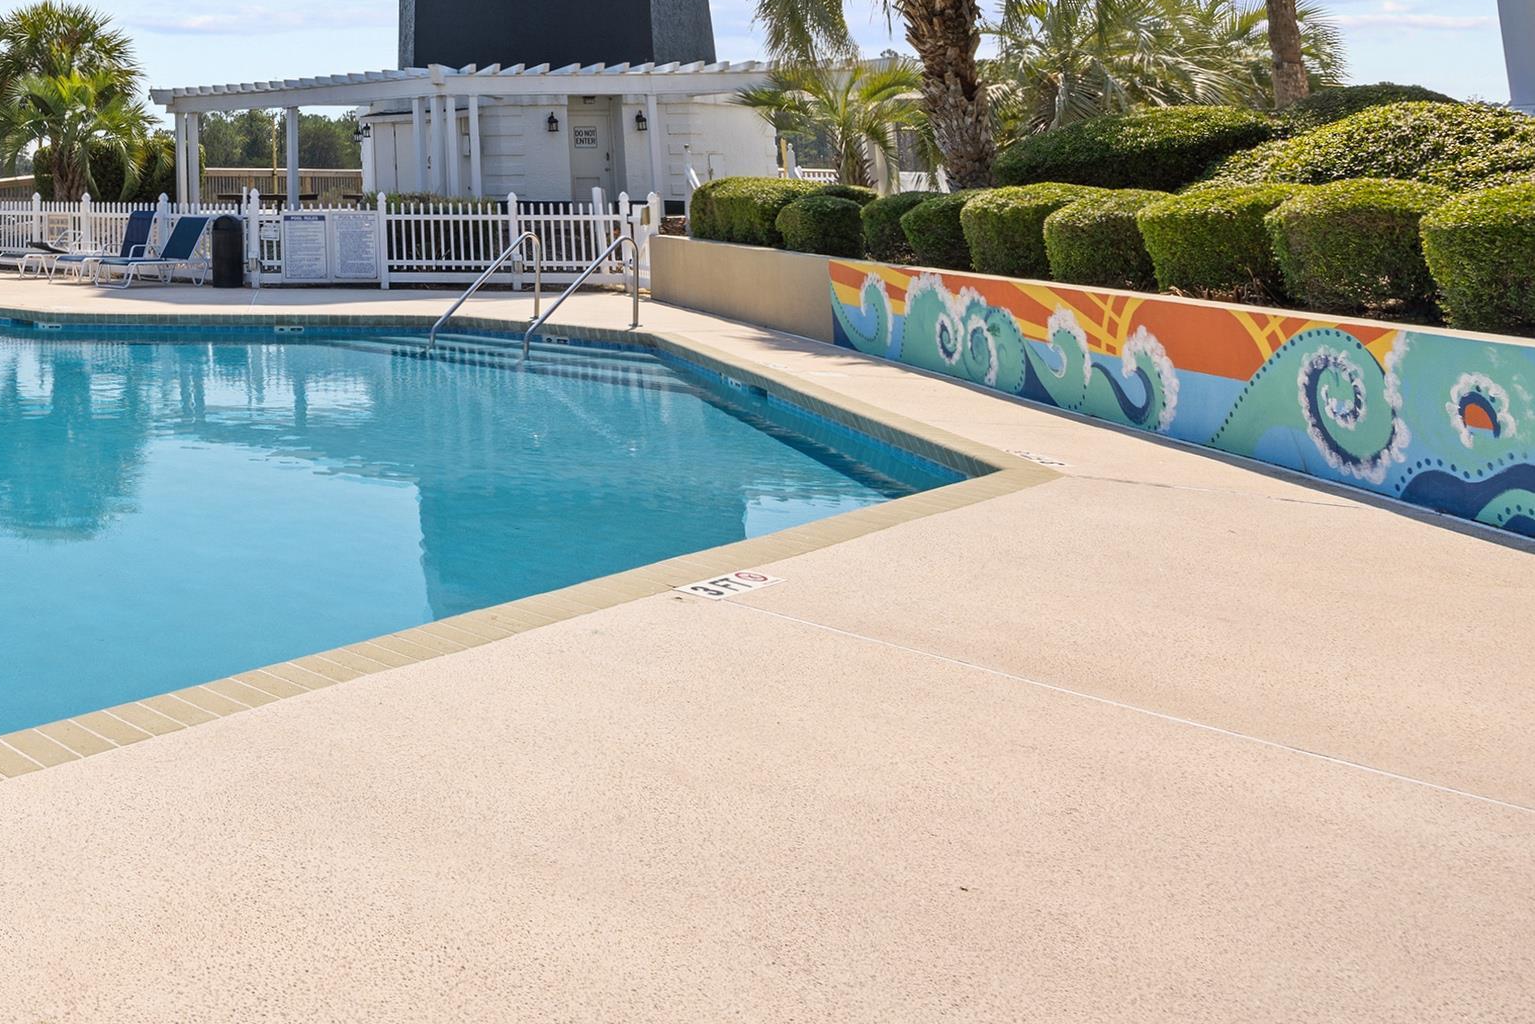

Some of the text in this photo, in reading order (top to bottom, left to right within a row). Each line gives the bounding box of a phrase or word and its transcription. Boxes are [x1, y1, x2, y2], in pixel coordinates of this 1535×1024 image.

[575, 129, 596, 137] DO NOT
[575, 137, 596, 145] ENTER
[690, 577, 752, 596] 3 FT
